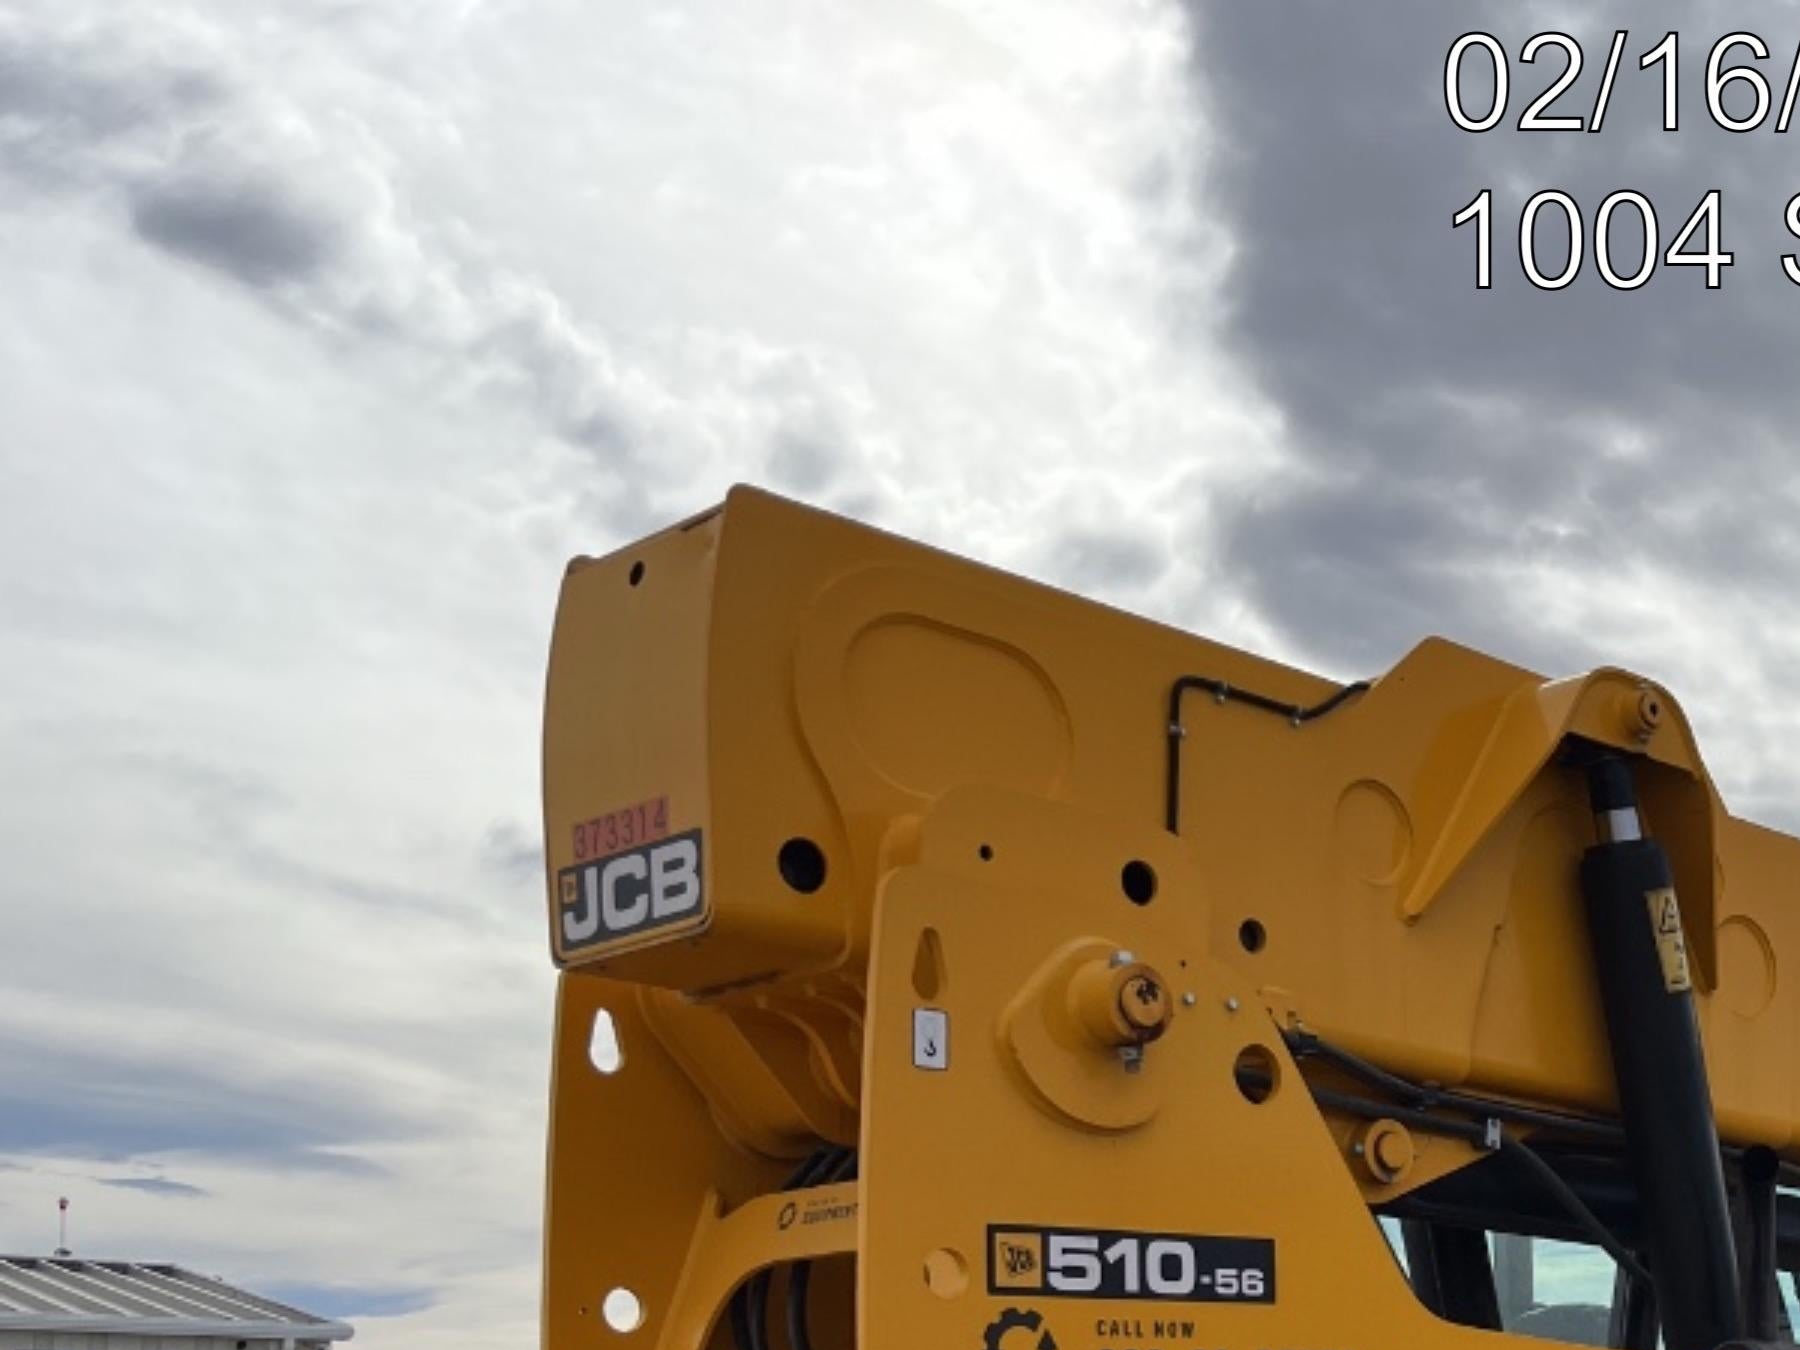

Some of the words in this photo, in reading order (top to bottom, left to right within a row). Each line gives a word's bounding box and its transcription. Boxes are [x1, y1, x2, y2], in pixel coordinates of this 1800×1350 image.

[574, 797, 667, 859] 373314
[563, 838, 700, 943] JCB
[1047, 1235, 1265, 1296] 510-56
[1096, 1320, 1144, 1339] CALL
[1154, 1321, 1196, 1339] NOW
